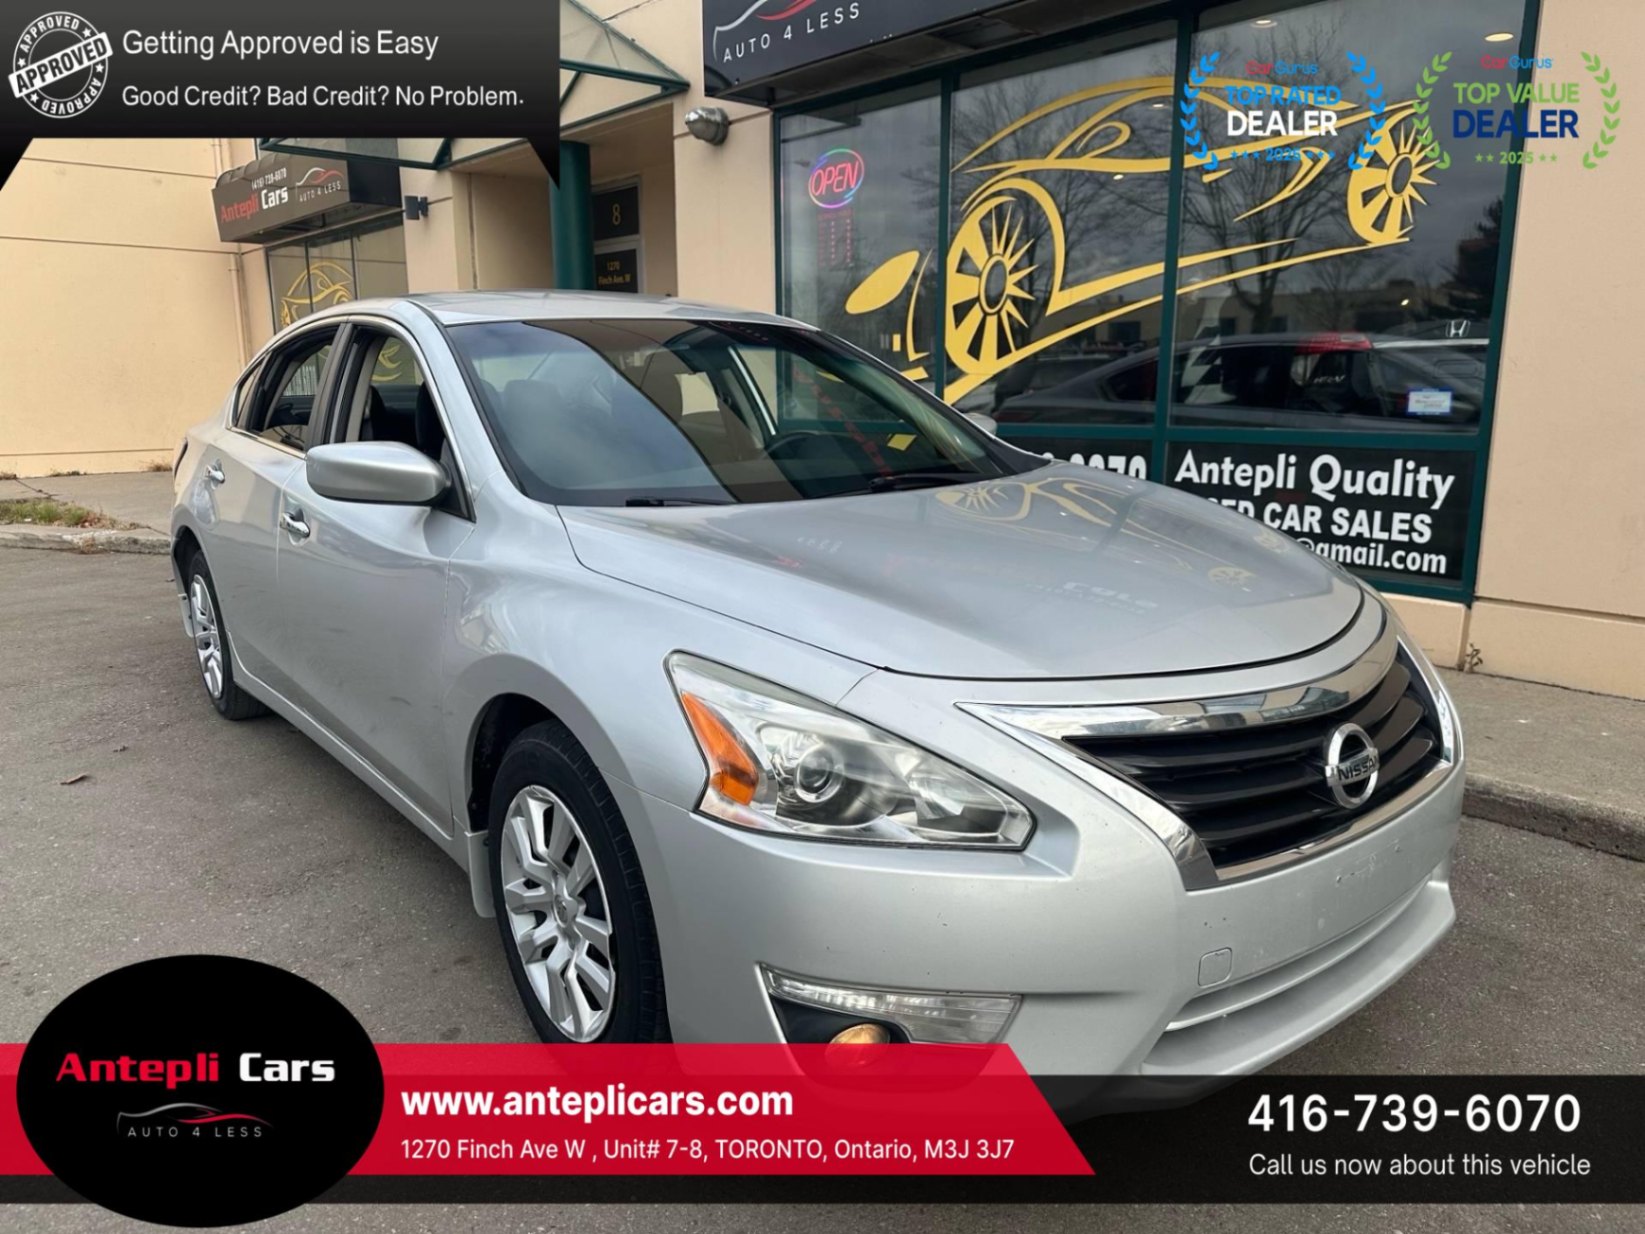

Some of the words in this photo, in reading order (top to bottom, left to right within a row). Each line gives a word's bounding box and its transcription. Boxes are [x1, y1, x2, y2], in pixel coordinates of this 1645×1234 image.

[723, 33, 771, 63] AUTO
[783, 25, 793, 41] 4
[806, 2, 860, 34] LESS
[324, 180, 342, 194] LESS
[811, 161, 860, 196] OPEN
[220, 191, 259, 223] Antepli
[261, 187, 288, 209] Cars
[612, 203, 621, 225] 8
[1174, 448, 1297, 496] Antepli
[1309, 453, 1455, 510] Quality
[1264, 502, 1322, 533] CAR
[1331, 508, 1433, 544] SALES
[1338, 756, 1377, 781] NISSAN
